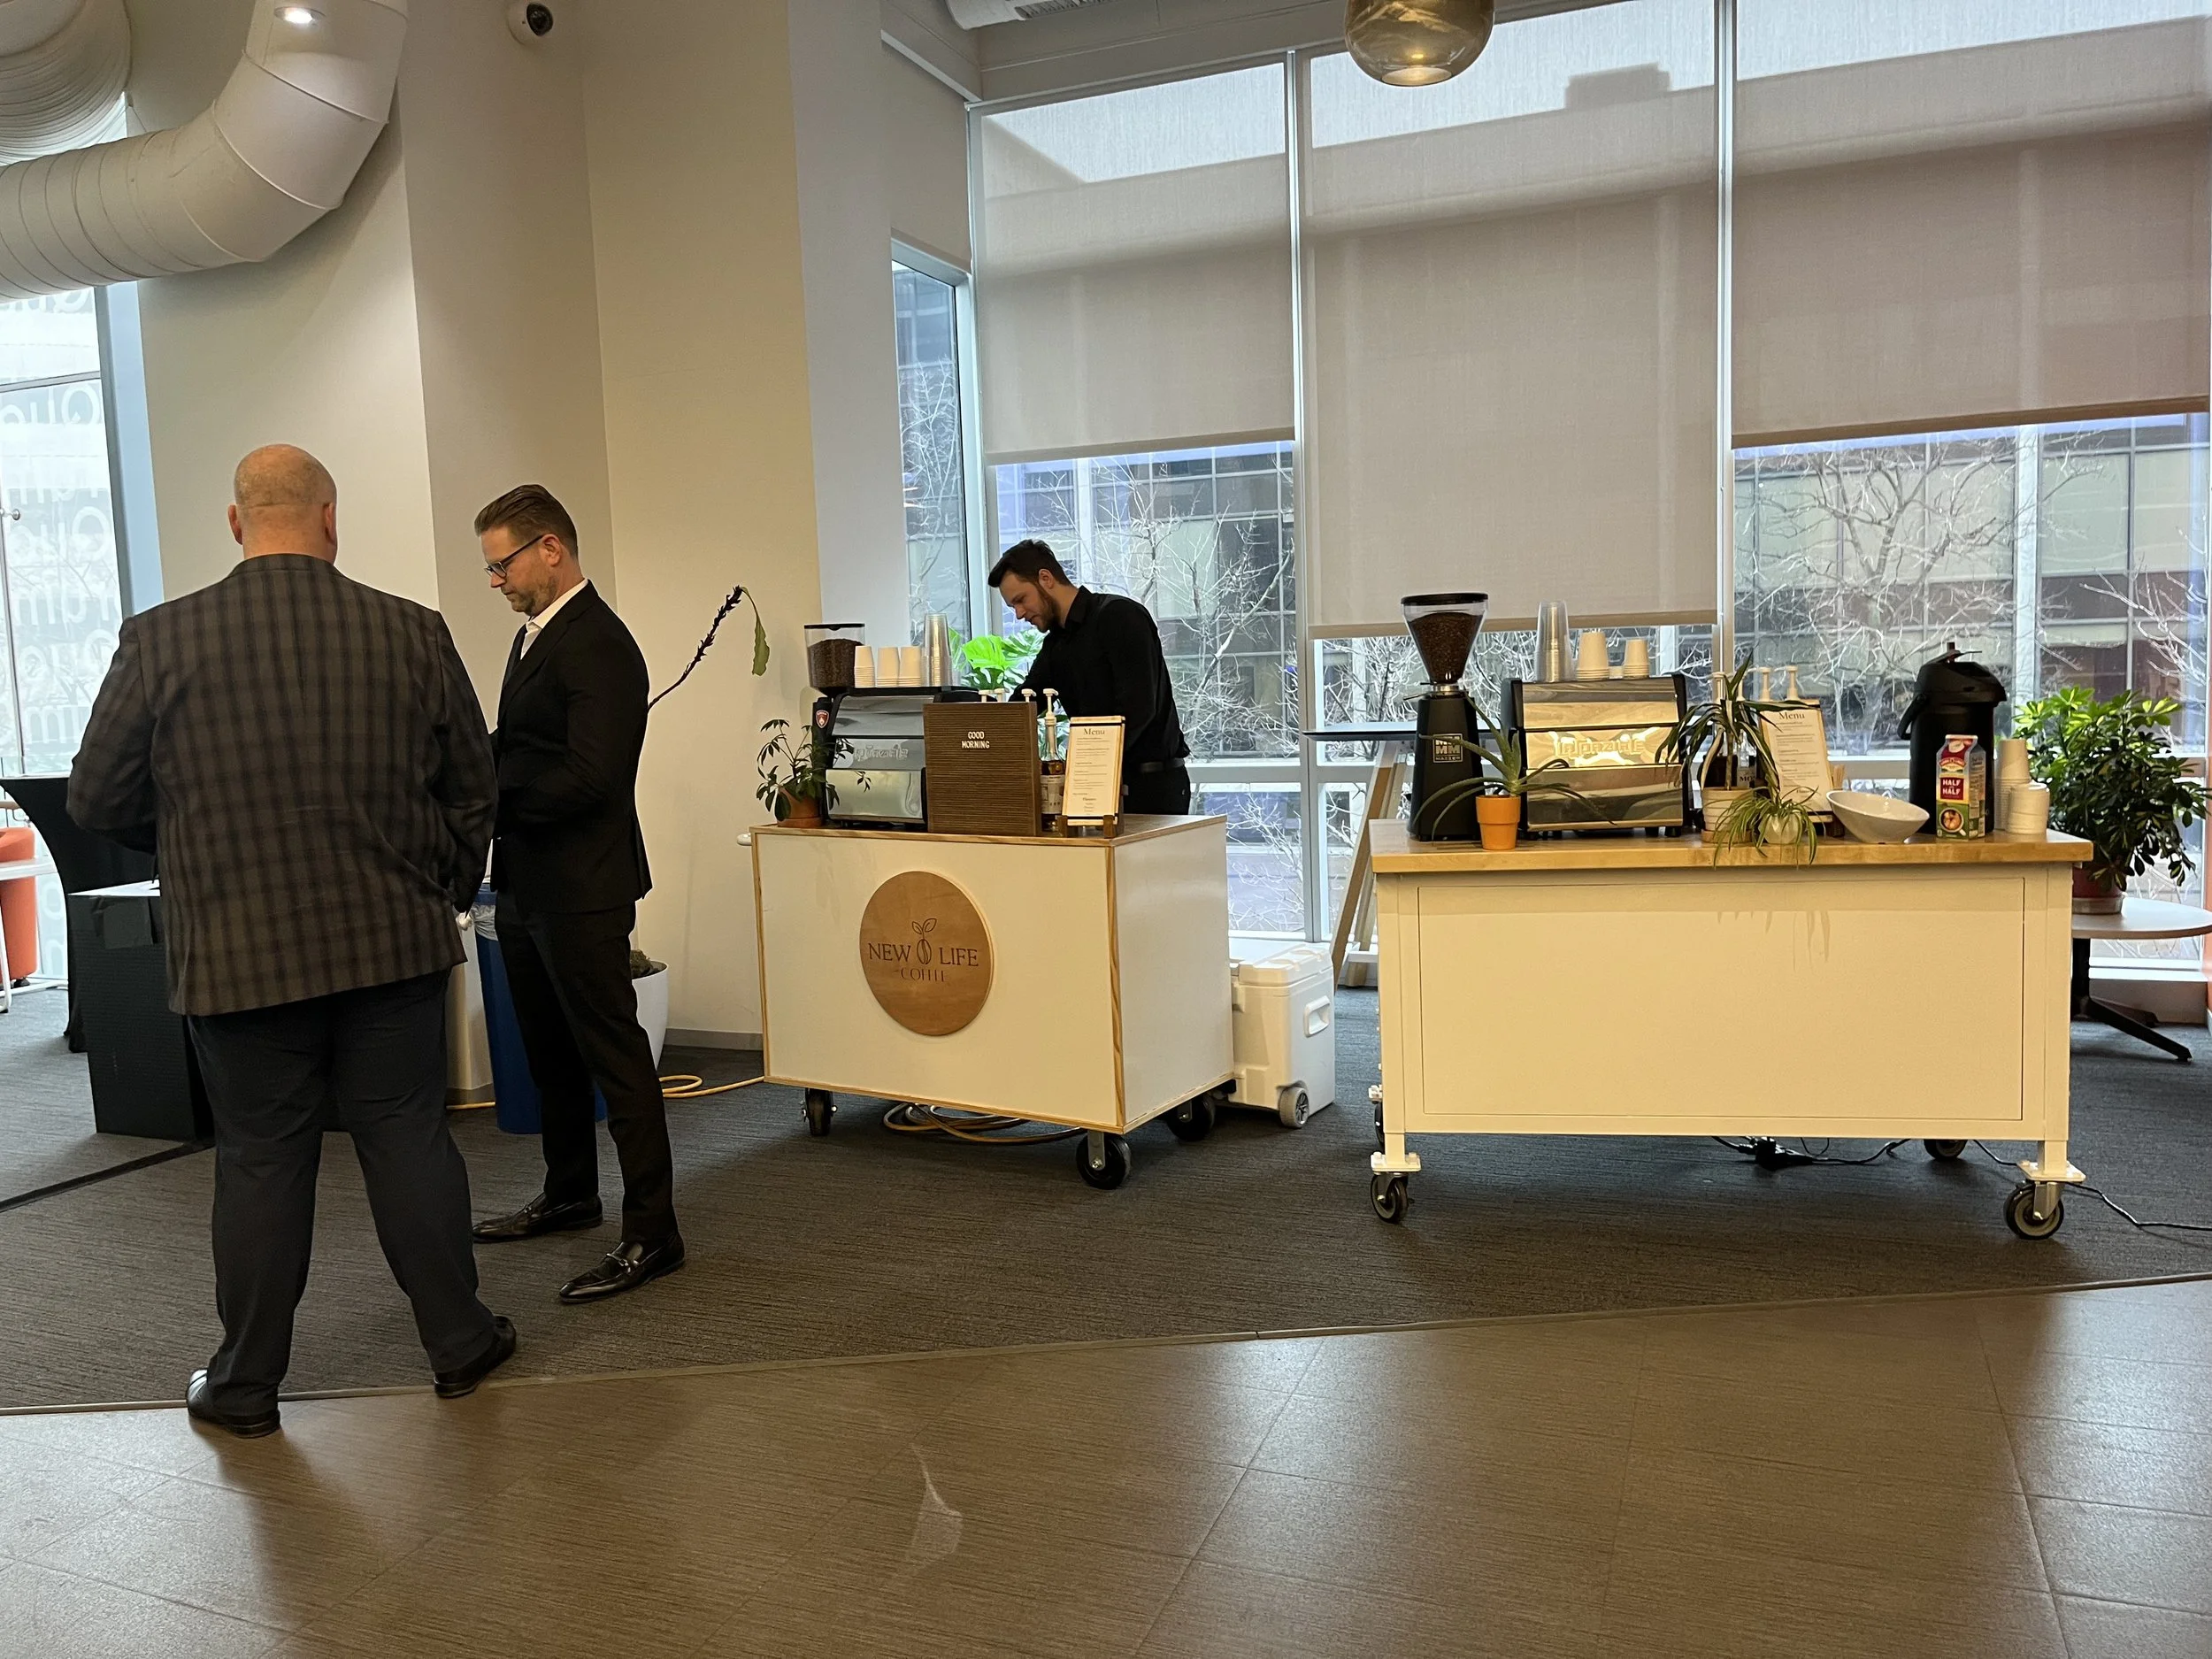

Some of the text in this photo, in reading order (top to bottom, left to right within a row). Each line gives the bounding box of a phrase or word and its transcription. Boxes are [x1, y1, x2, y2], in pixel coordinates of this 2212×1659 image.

[1779, 711, 1806, 720] Menu
[967, 731, 985, 740] GOOD
[961, 740, 990, 749] MORNING
[868, 942, 979, 968] NEW LIFE
